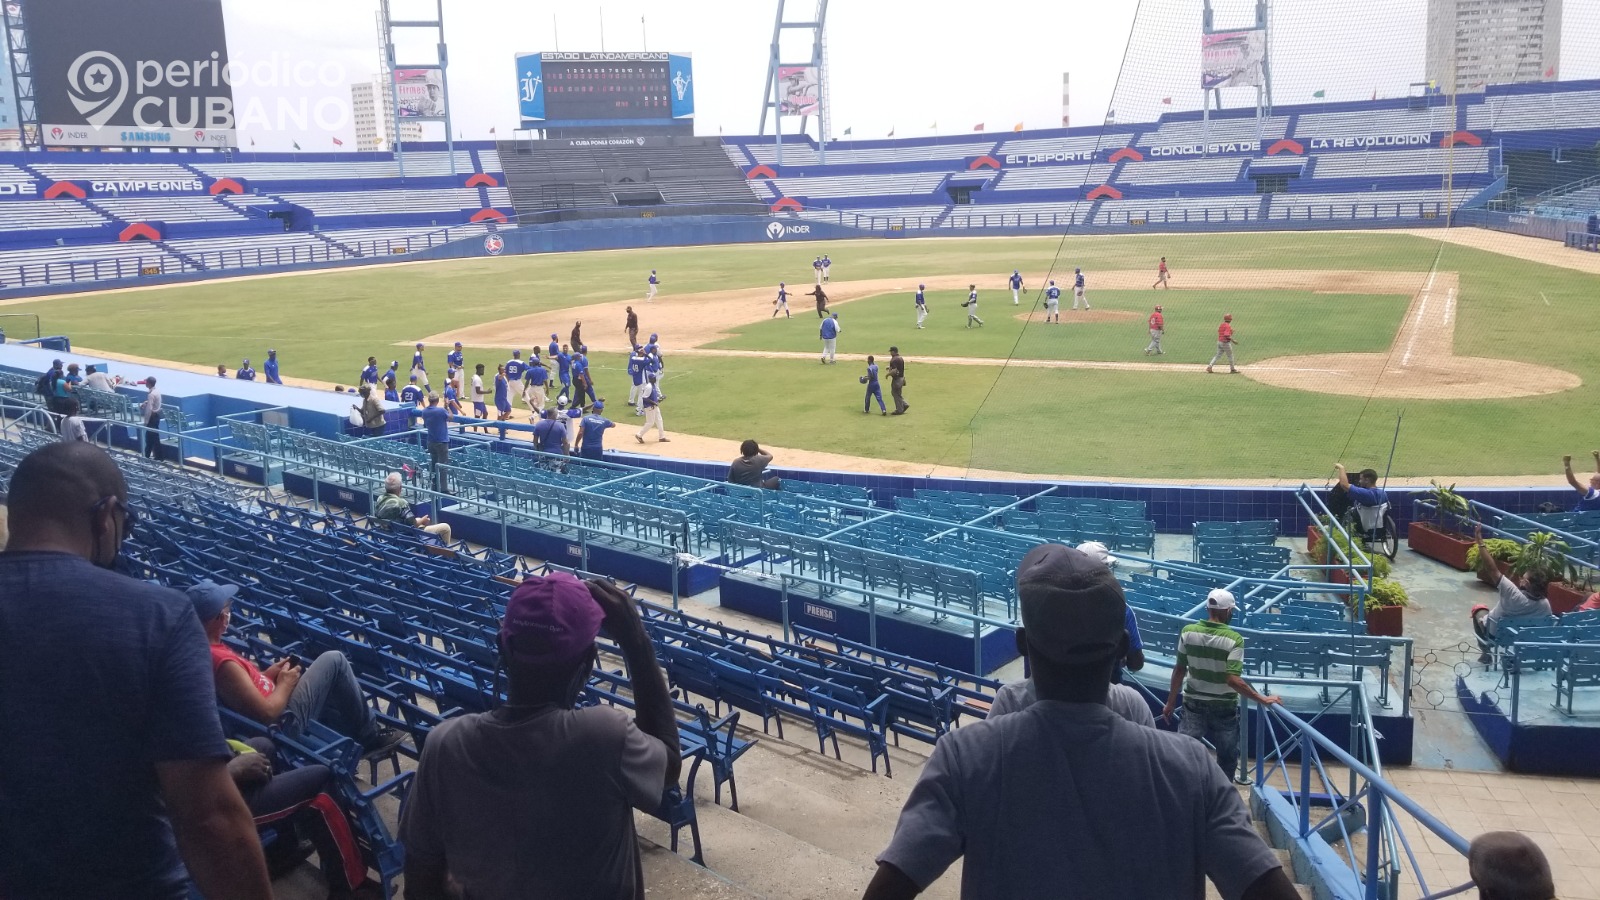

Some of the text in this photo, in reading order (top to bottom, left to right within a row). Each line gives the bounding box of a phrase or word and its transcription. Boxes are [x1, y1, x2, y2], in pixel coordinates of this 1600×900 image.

[541, 52, 669, 60] ESTADIO LATINOAMERICANO
[67, 131, 88, 139] INDER
[120, 131, 171, 143] SAMSUNG
[1310, 138, 1330, 149] LA
[1150, 142, 1261, 157] CONQUISTA DE
[1006, 153, 1024, 164] EL
[0, 183, 37, 195] DE
[91, 180, 204, 192] CAMPEONES
[786, 225, 811, 234] INDER
[508, 366, 518, 374] 99
[404, 392, 414, 400] 23
[806, 604, 833, 620] PRENSA
